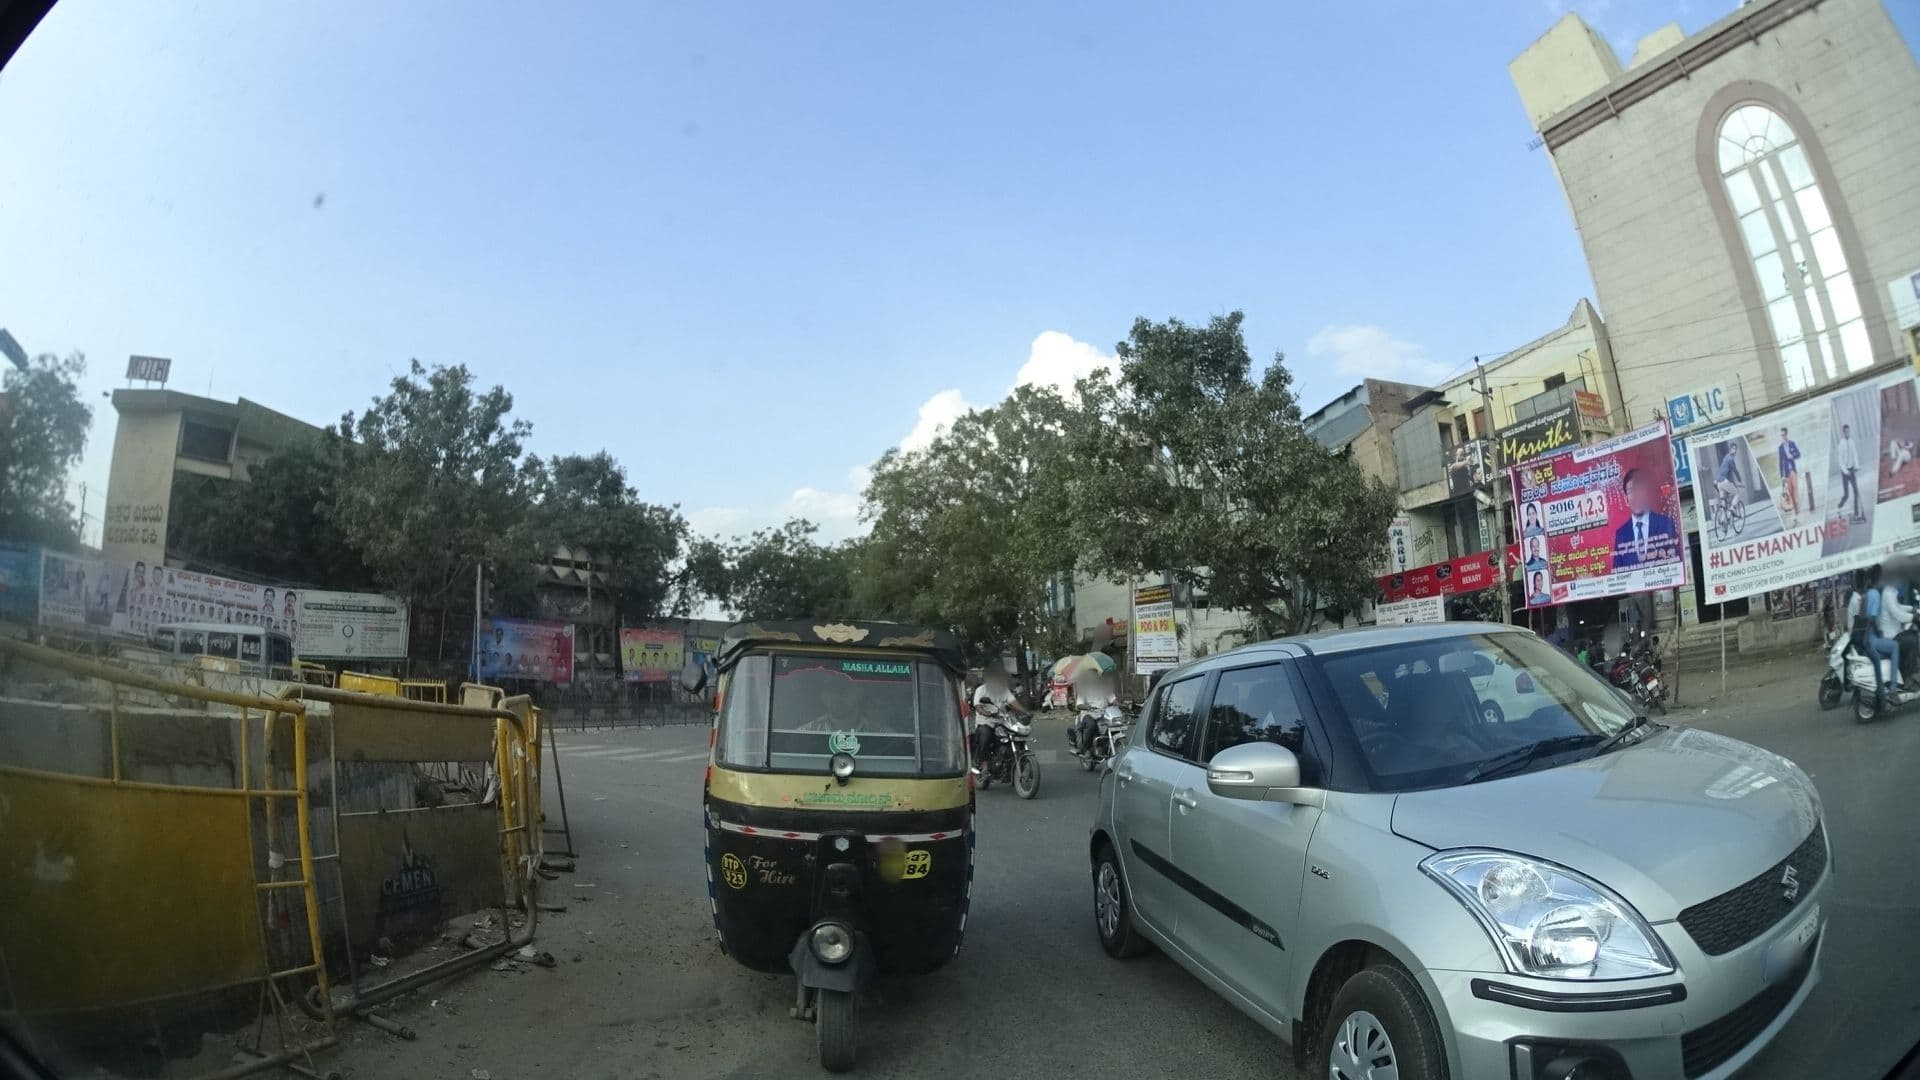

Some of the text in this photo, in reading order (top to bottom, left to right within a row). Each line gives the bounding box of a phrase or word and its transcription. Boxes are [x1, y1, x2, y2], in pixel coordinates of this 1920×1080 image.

[1695, 387, 1724, 418] LIC
[1503, 419, 1573, 463] Maruthi
[1549, 500, 1575, 515] 2016
[1746, 559, 1785, 576] COLLECTION
[842, 662, 874, 673] MASHA
[749, 855, 777, 870] For
[759, 869, 796, 884] Hire
